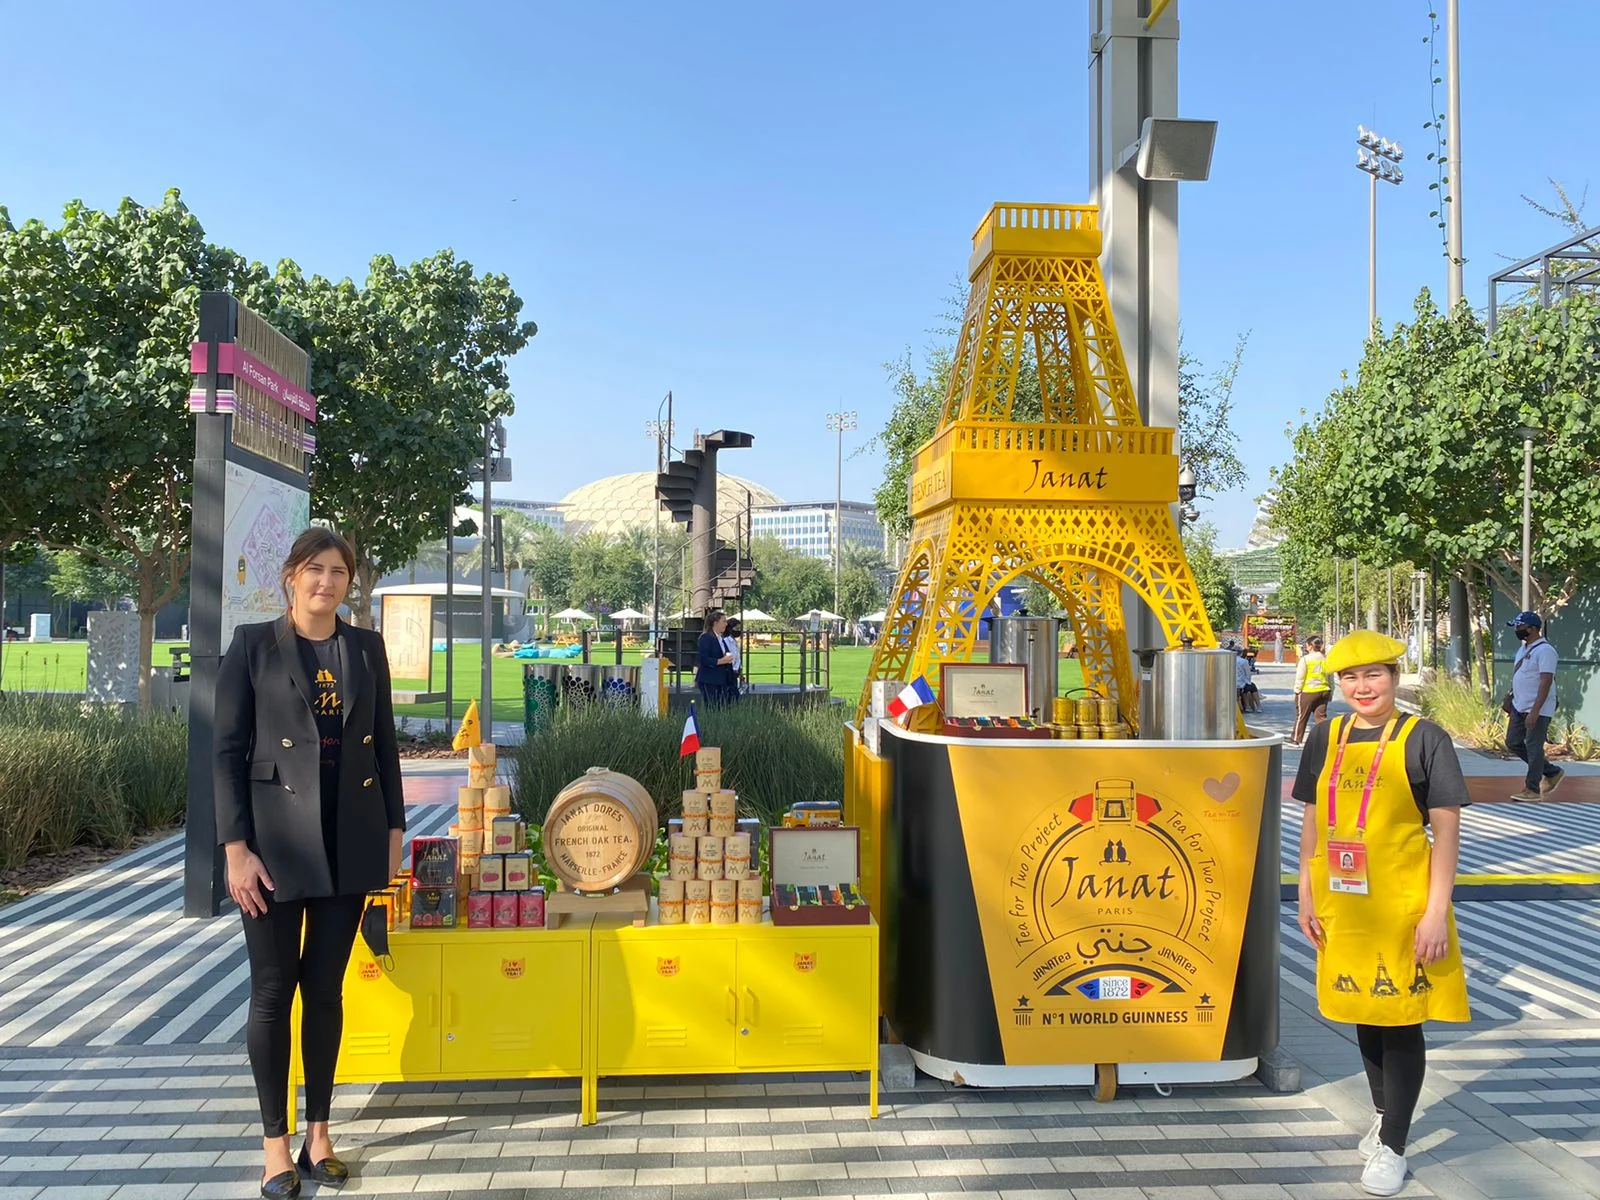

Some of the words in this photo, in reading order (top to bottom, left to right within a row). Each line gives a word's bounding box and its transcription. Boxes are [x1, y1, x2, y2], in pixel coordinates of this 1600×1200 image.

[242, 360, 249, 374] Al
[249, 364, 267, 386] Forsan
[267, 376, 279, 393] Park
[1024, 459, 1108, 494] Janat
[1336, 772, 1384, 789] Jant
[560, 803, 589, 826] JANAT
[1166, 810, 1187, 834] Tea
[554, 837, 588, 847] FRENCH
[591, 836, 609, 845] OAK
[577, 825, 608, 833] ORIGINAL
[1020, 813, 1063, 861] Project
[1183, 832, 1204, 853] for
[560, 853, 598, 876] MARSEILLE
[602, 850, 628, 874] FRANCE
[1010, 862, 1030, 889] Two
[1199, 856, 1216, 884] Two
[1051, 856, 1176, 907] Janat
[1008, 895, 1028, 917] for
[1097, 907, 1133, 915] PARIS
[1198, 889, 1221, 942] Project
[1015, 922, 1034, 947] Tea
[1077, 928, 1153, 965] جنتي
[1033, 951, 1072, 982] JANATea
[1157, 946, 1198, 975] JANATea
[1102, 976, 1129, 987] since
[1102, 987, 1129, 998] 1872
[1070, 1012, 1119, 1025] WORLD
[1122, 1010, 1188, 1024] GUINNESS
